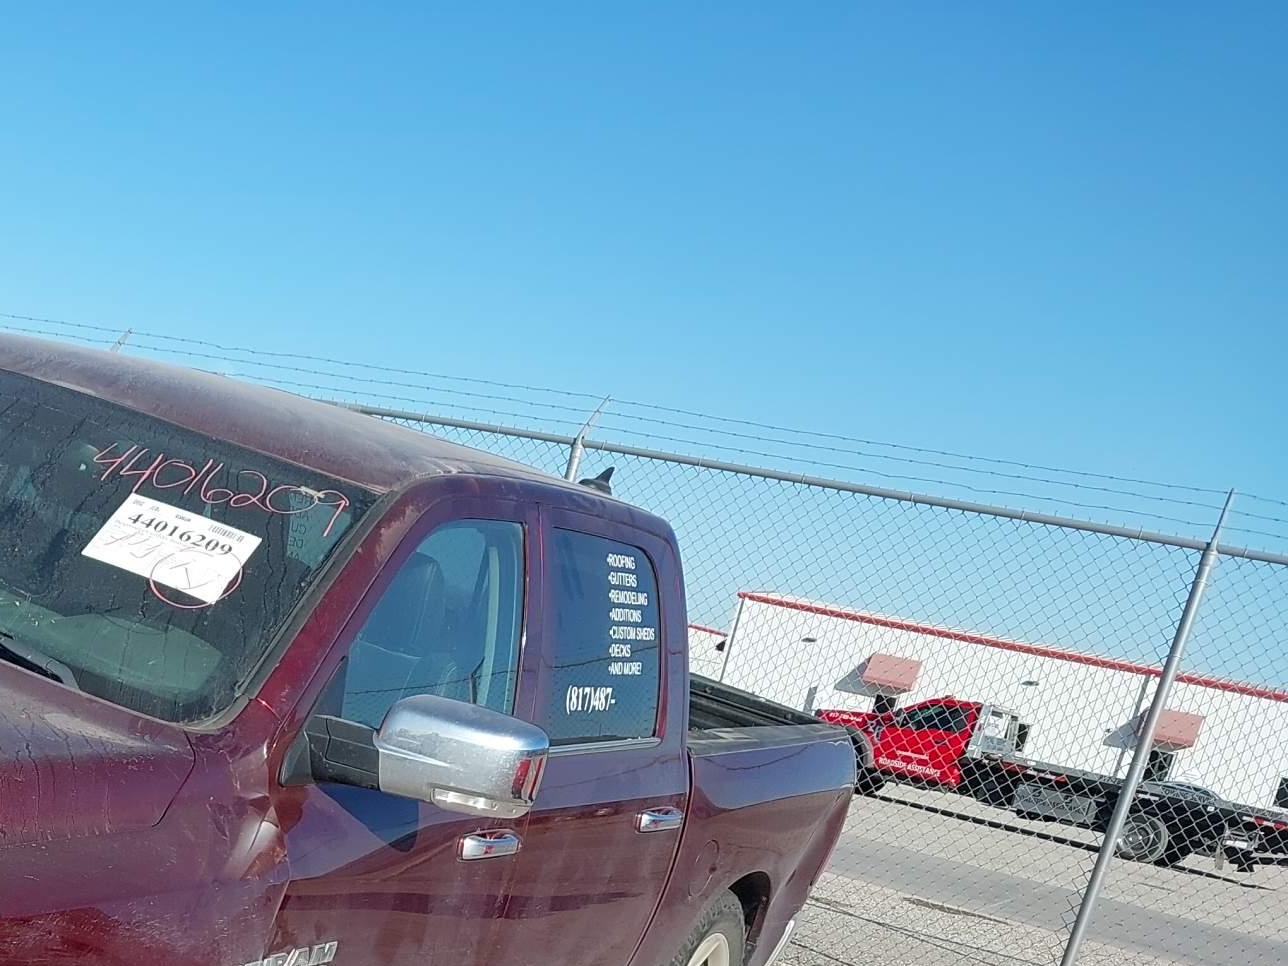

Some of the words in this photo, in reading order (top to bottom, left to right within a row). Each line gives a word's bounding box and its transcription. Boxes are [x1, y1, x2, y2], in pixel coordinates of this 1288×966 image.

[93, 442, 350, 538] 44016209
[127, 513, 234, 555] 44016209
[636, 627, 655, 641] SHEDS
[623, 661, 643, 675] MORE!
[566, 685, 616, 714] (817)487-
